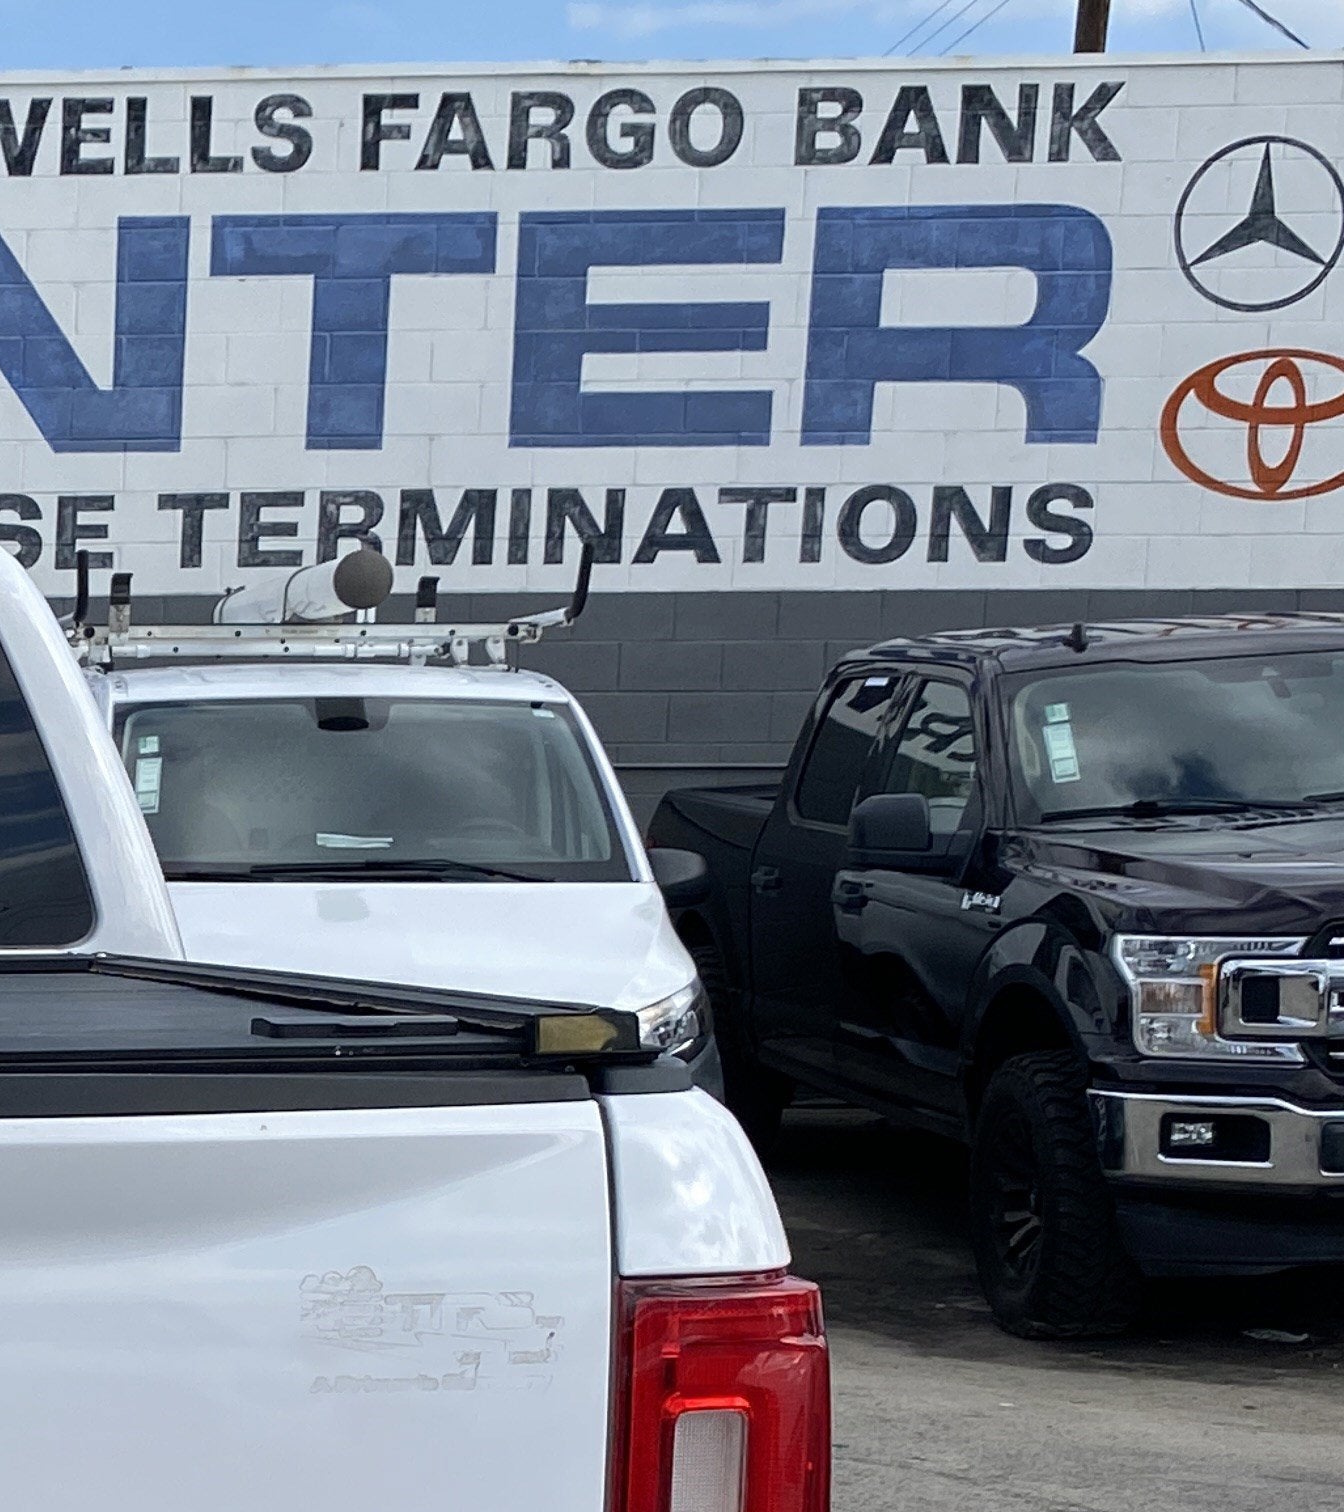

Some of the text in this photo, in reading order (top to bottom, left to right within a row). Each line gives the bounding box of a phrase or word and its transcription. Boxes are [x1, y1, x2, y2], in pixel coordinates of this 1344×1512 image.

[359, 86, 746, 170] FARGO
[793, 81, 1127, 165] BANK
[157, 483, 1095, 569] TERMINATIONS
